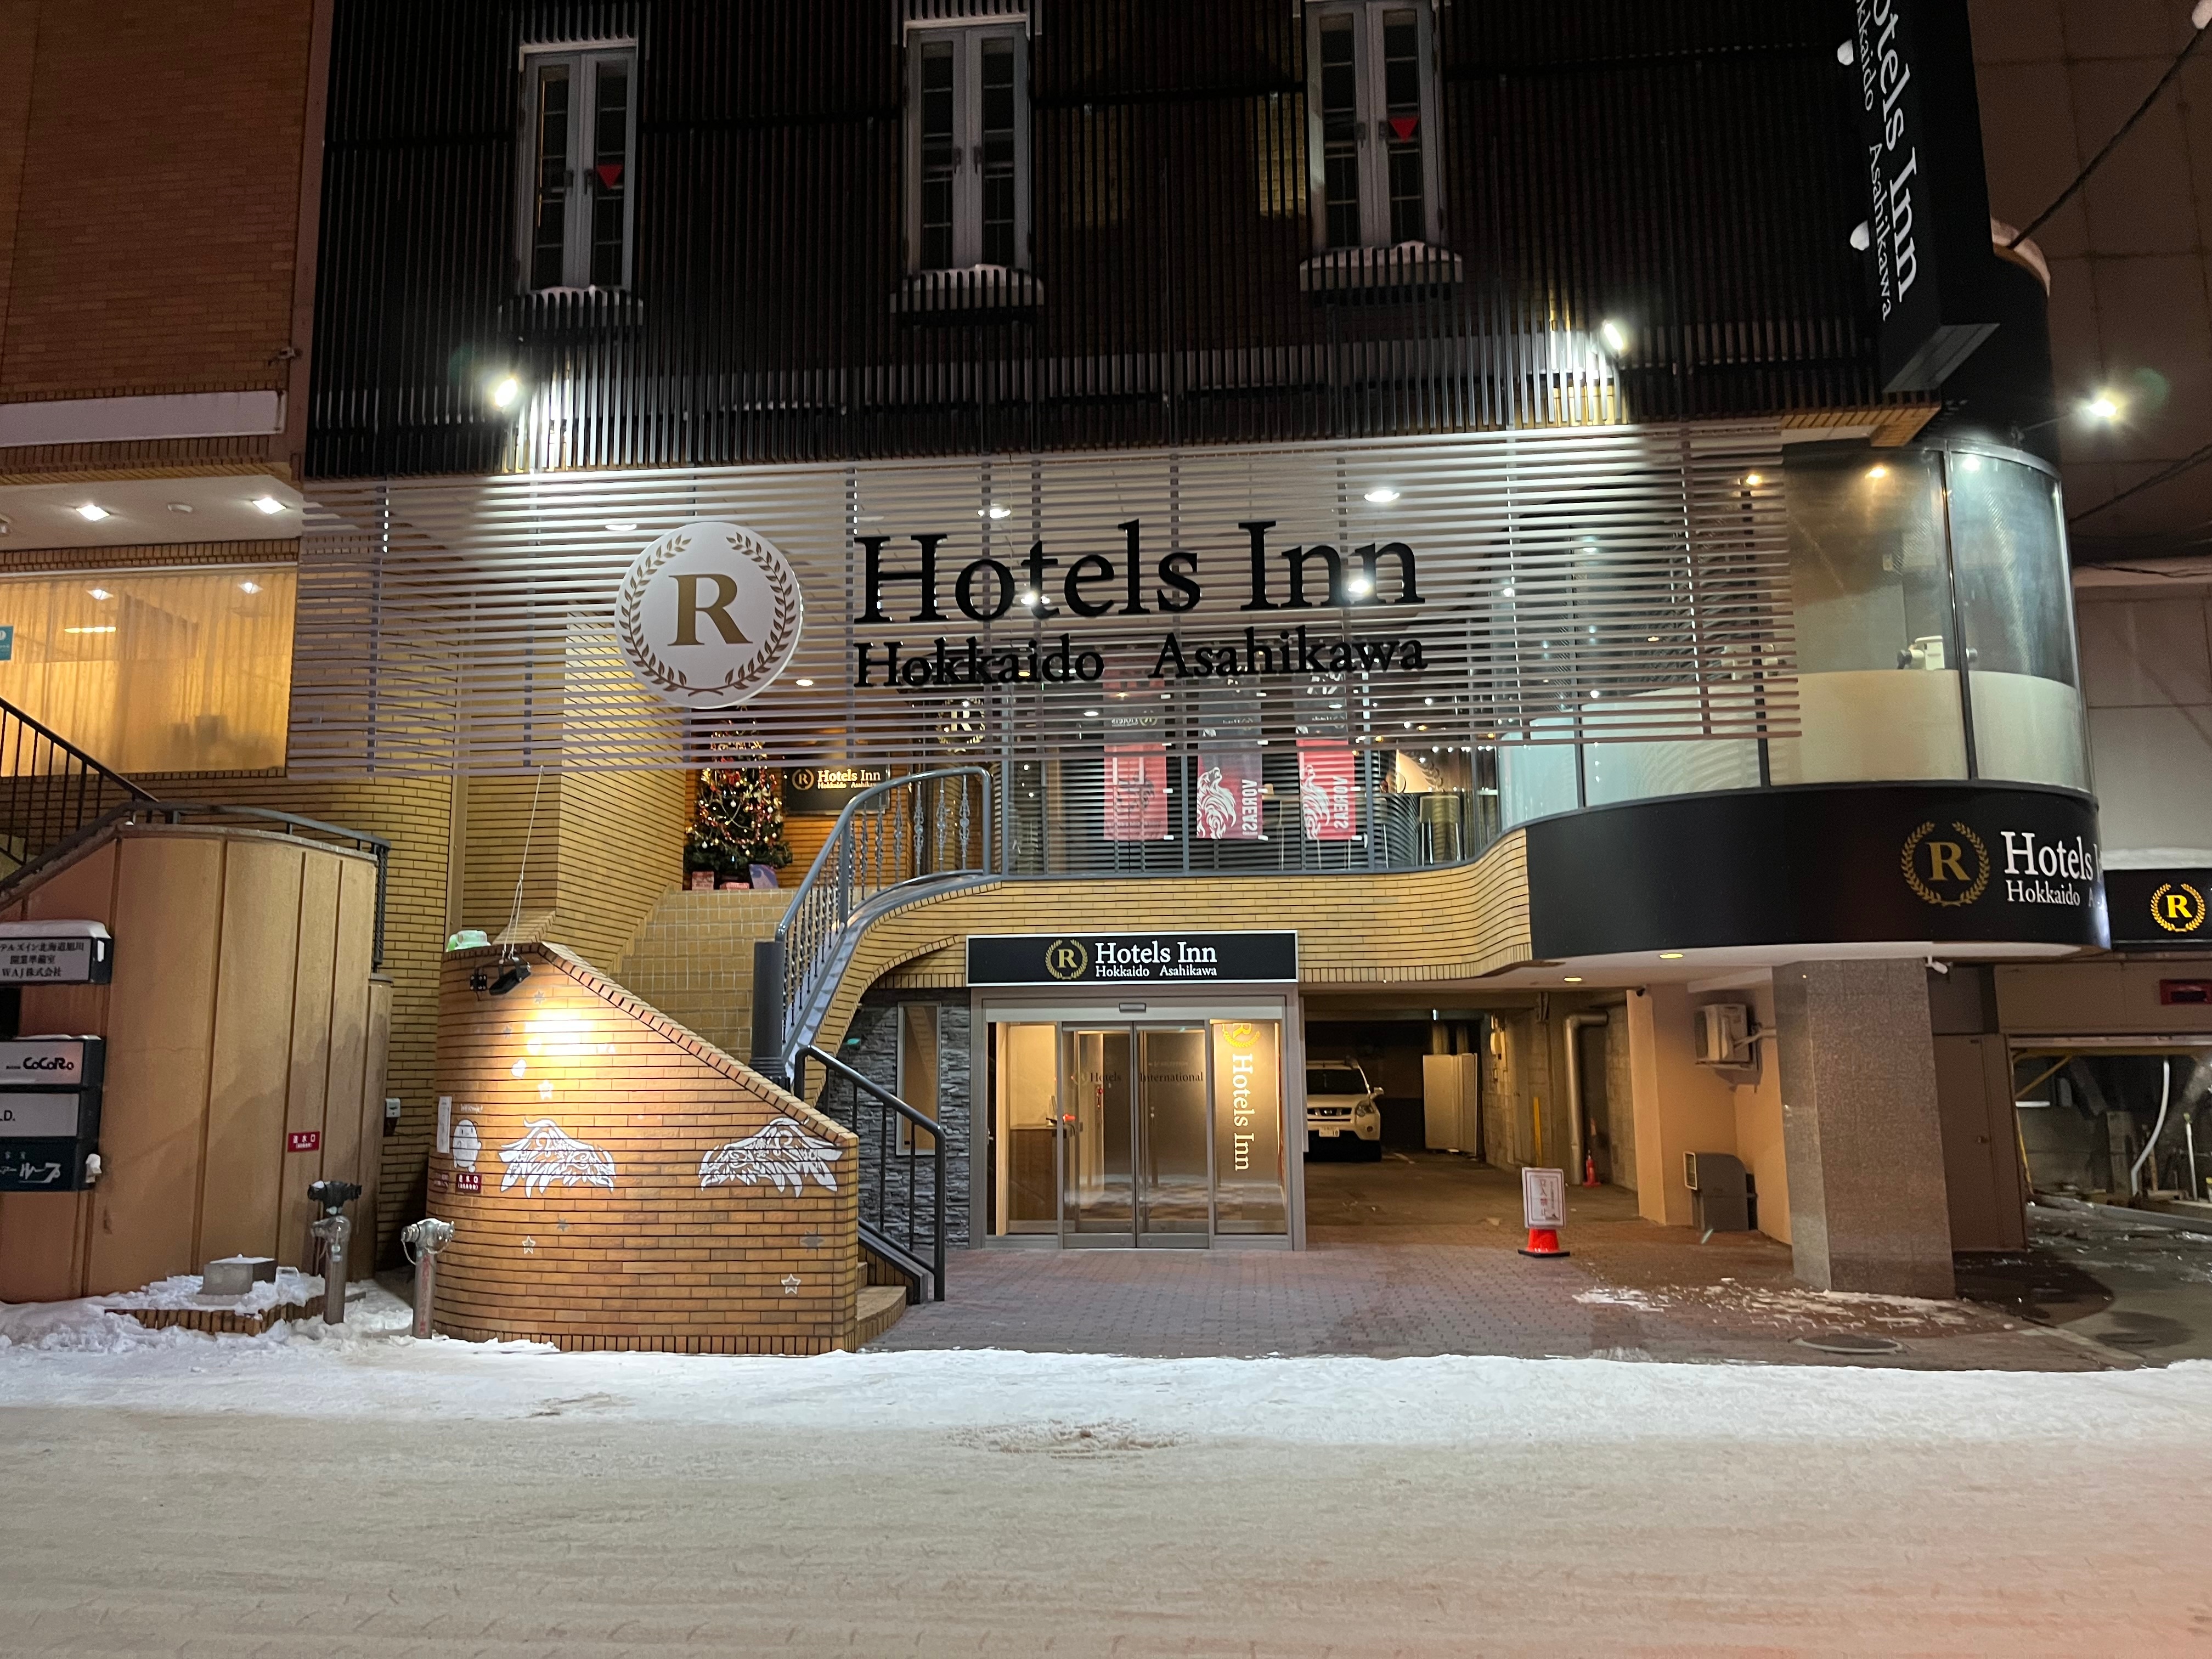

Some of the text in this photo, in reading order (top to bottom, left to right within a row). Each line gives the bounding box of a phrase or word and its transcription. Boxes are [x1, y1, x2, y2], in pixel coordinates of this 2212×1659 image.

[1856, 0, 1892, 321] kkaido Asahikawa
[1889, 146, 1917, 302] Inn
[853, 518, 1426, 624] Hotels Inn
[667, 573, 753, 647] R
[853, 624, 1428, 688] Hokkaido Asahikawa
[817, 769, 881, 782] Hotels Inn
[1926, 842, 1971, 882] R
[2000, 831, 2093, 881] Hotels
[2006, 879, 2080, 907] Hokkaido
[2166, 894, 2193, 919] R
[1058, 950, 1076, 968] R
[1095, 941, 1218, 964] Hotels Inn
[1095, 964, 1218, 978] Hokkaido Asahikawa
[1090, 1071, 1203, 1082] Hotels International
[1232, 1053, 1255, 1171] Hotels Inn
